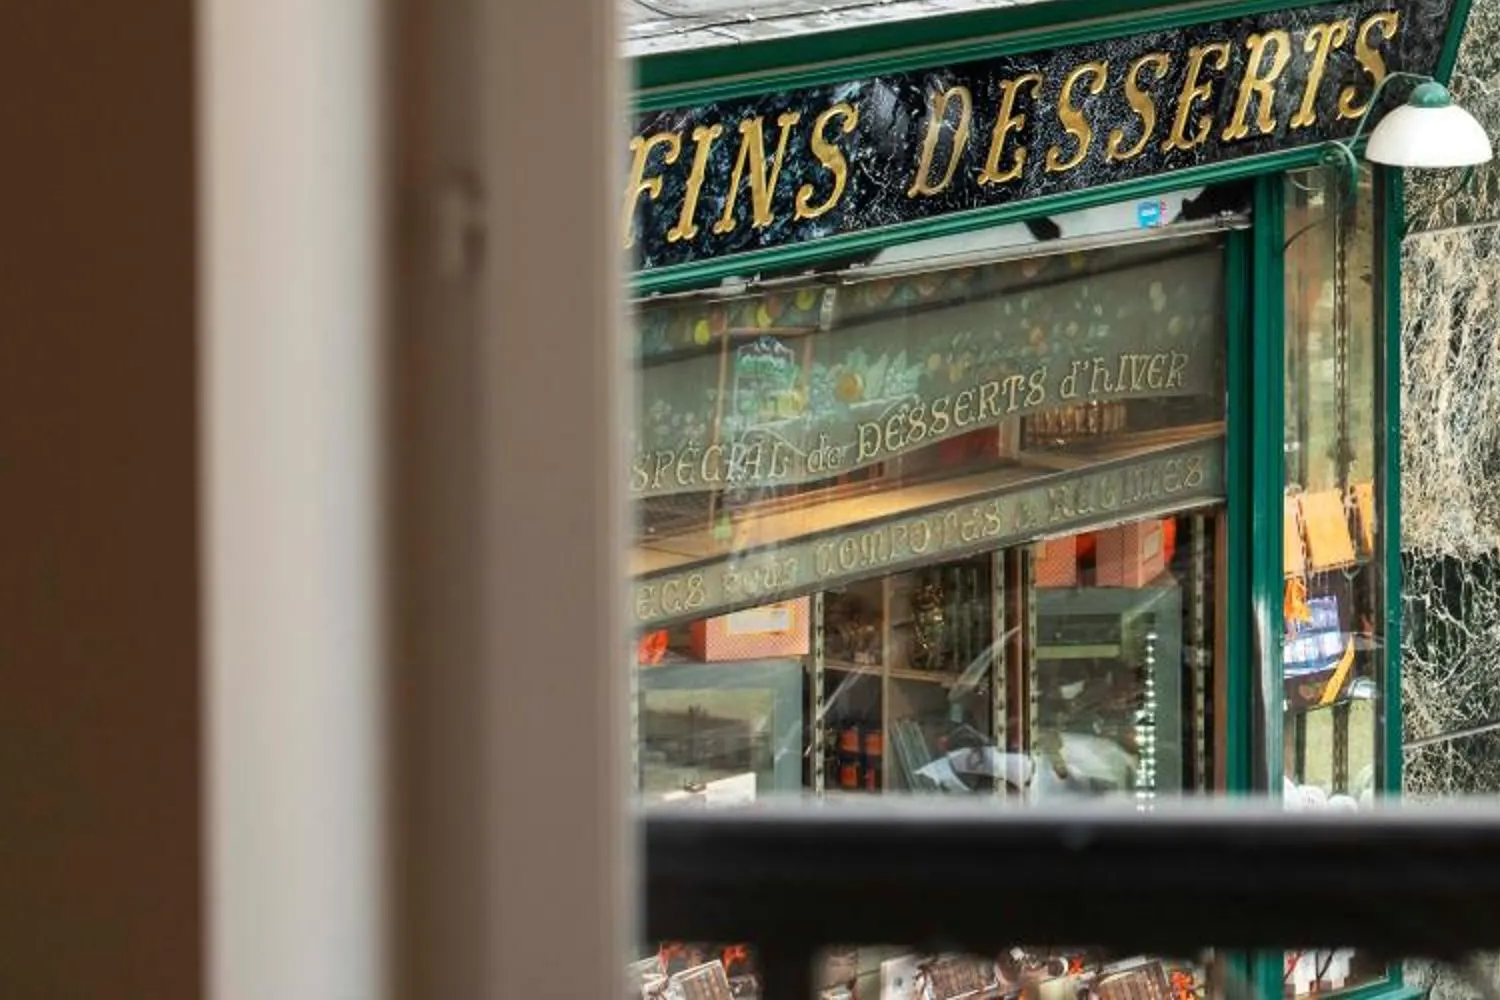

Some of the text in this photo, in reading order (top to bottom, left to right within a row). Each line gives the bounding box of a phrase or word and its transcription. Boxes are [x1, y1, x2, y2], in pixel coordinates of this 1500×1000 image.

[622, 10, 1400, 250] FINS DESSERTS
[855, 365, 1048, 464] DESSERTS
